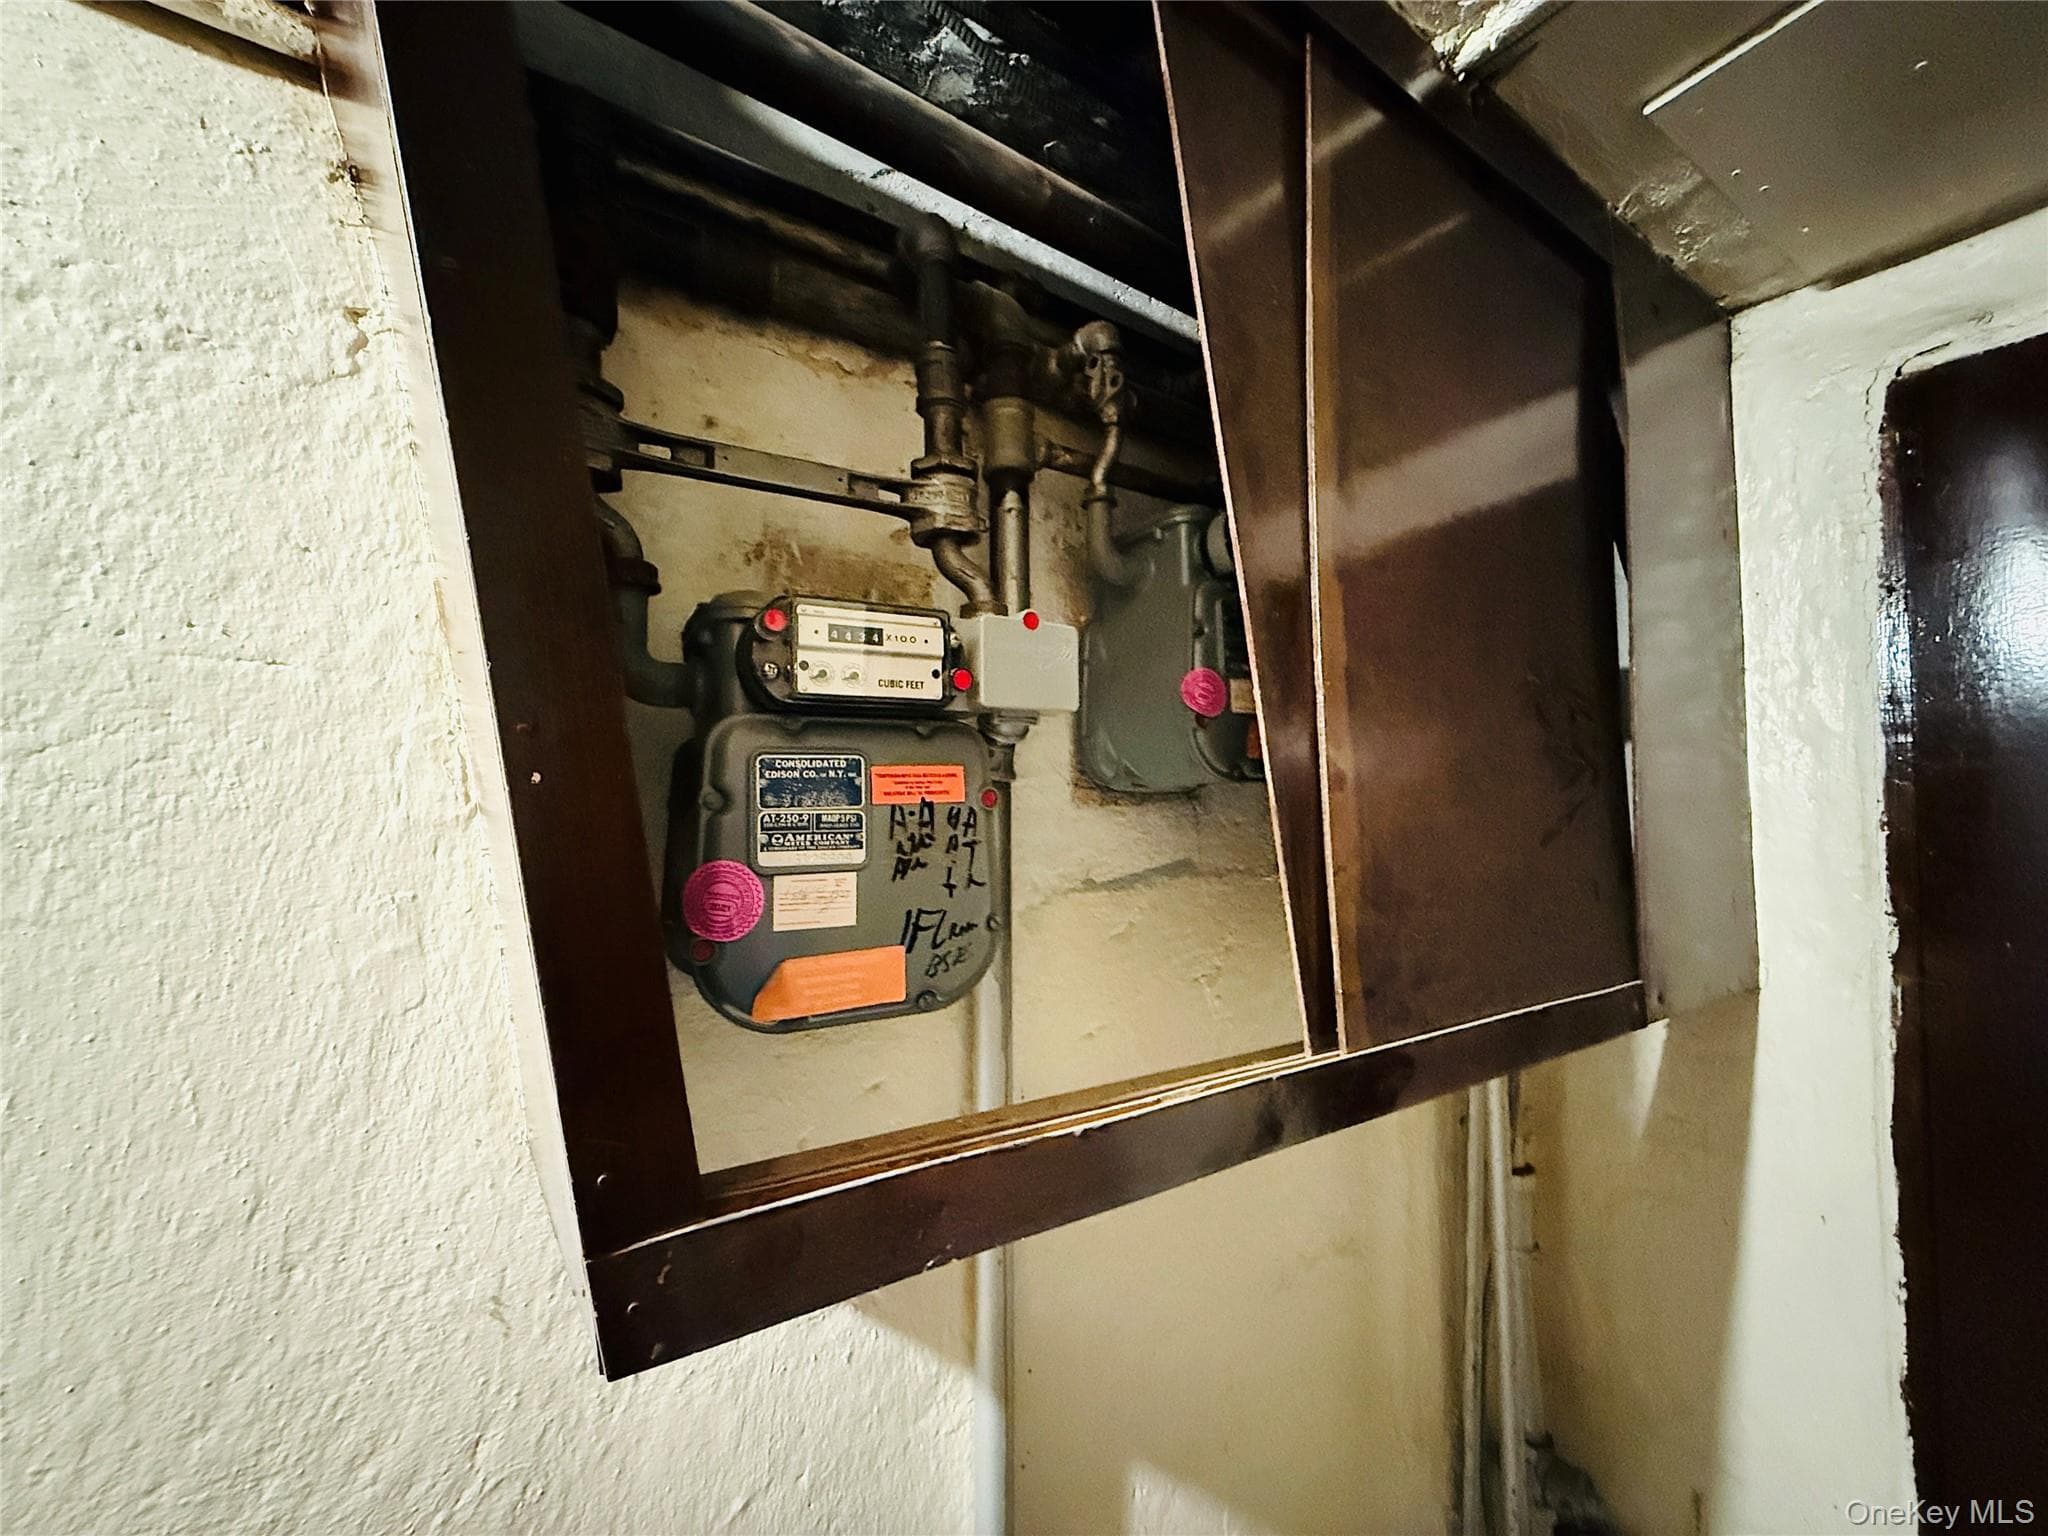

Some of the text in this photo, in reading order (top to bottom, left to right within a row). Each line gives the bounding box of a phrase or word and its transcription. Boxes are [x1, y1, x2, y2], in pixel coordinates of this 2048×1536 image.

[878, 679, 926, 690] CUBIC FEET
[775, 759, 847, 768] CONSOLIDATED
[765, 769, 800, 779] EDISON
[762, 814, 810, 823] AT-250-9
